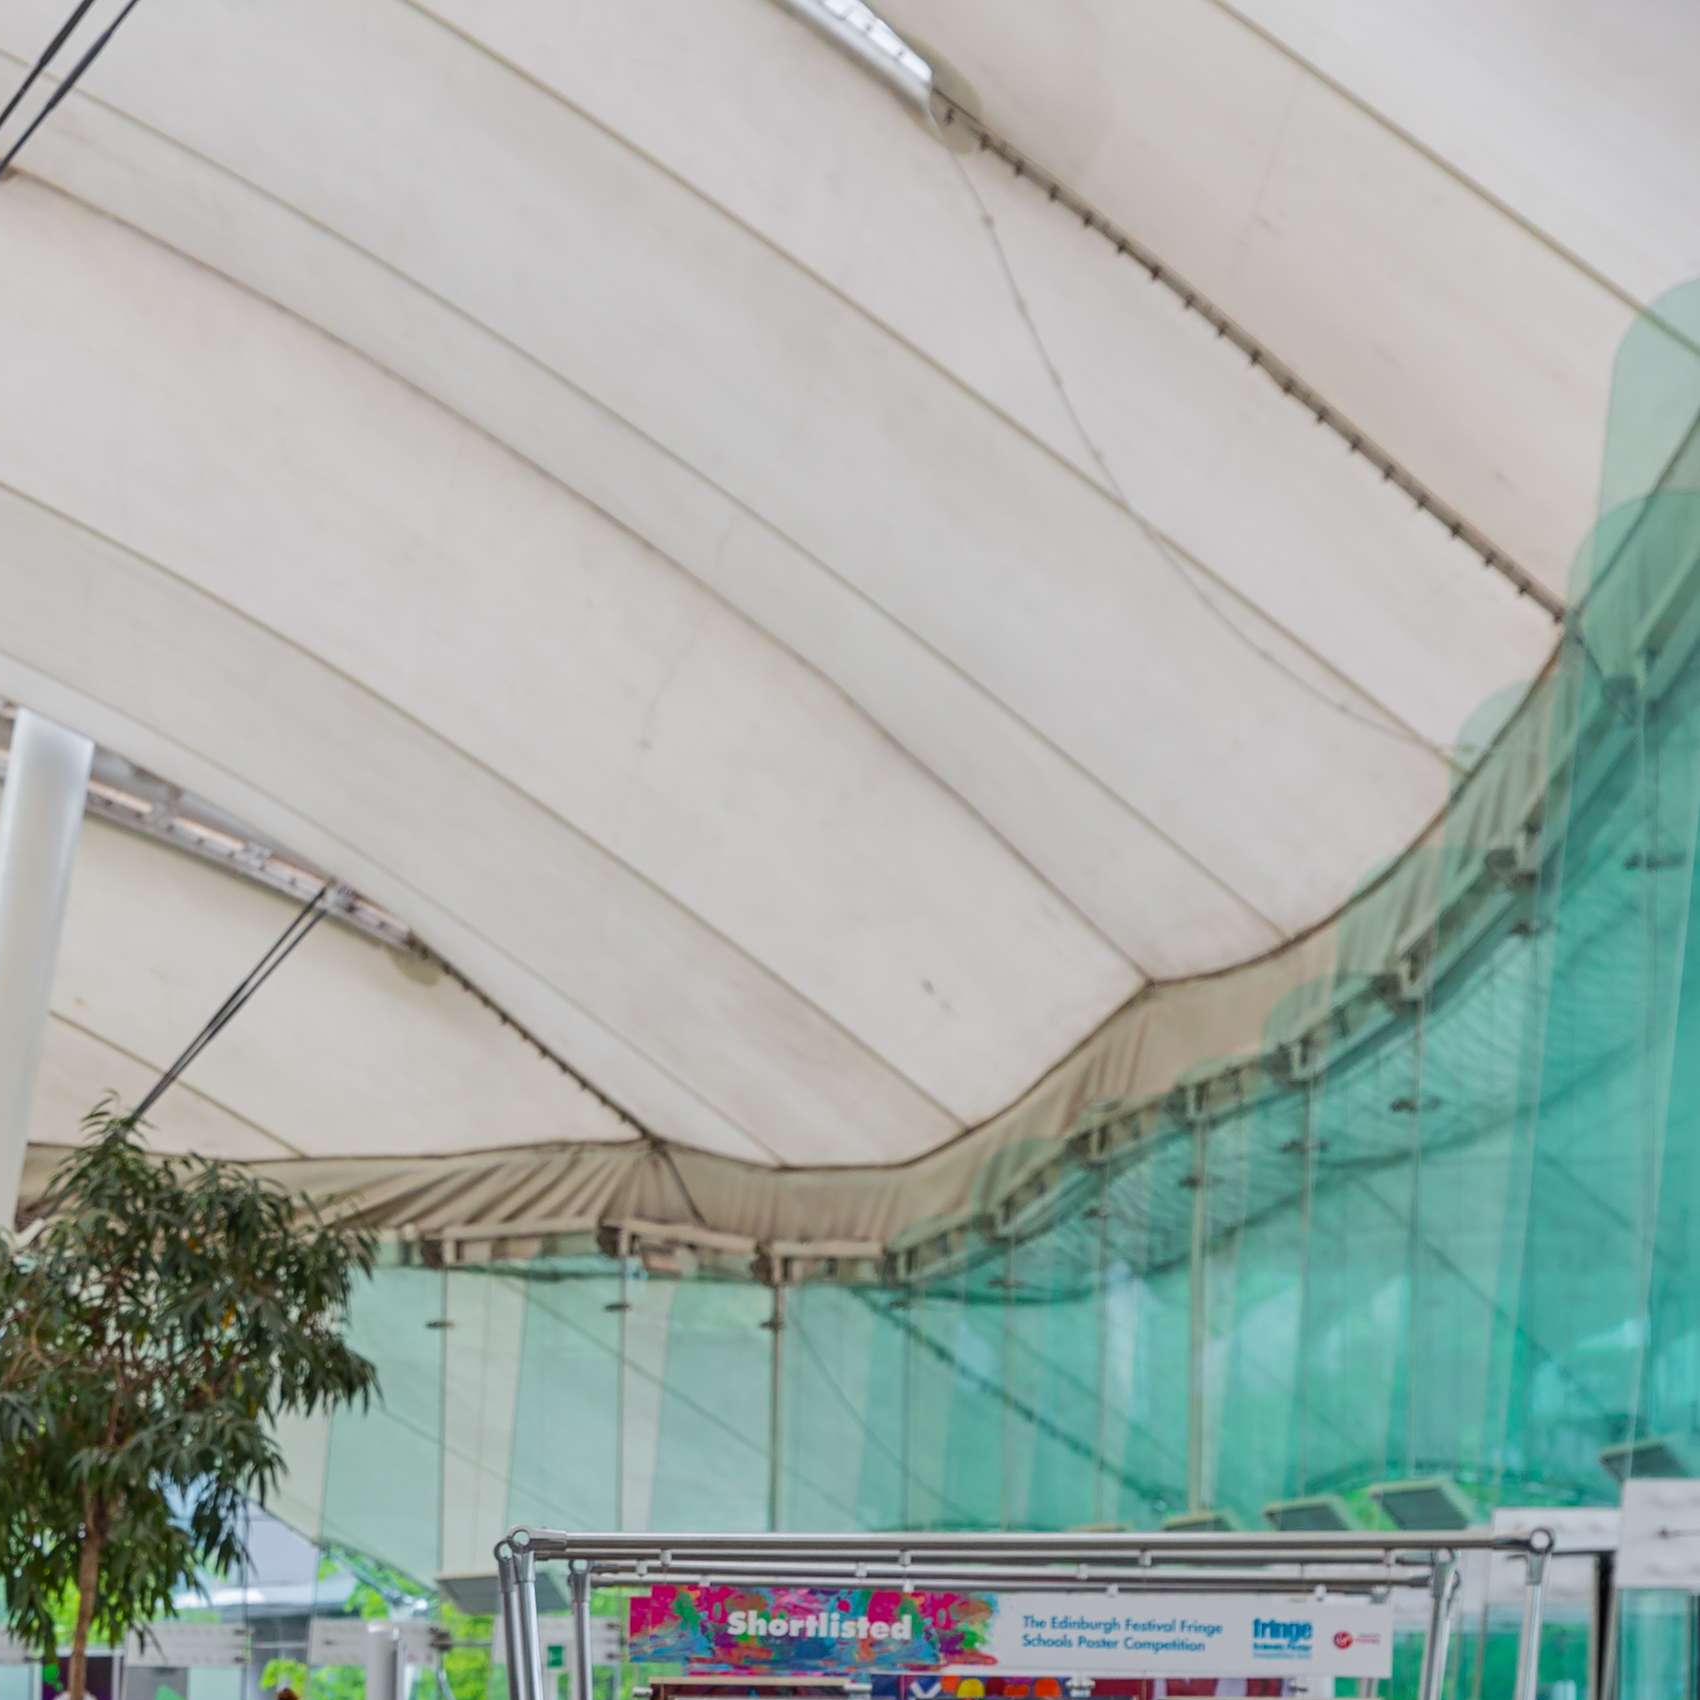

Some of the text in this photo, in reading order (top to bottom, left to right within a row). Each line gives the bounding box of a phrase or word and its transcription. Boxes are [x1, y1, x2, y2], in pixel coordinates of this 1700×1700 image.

[727, 1610, 912, 1640] Shortlisted
[1022, 1615, 1224, 1638] The Edinburgh Festival Fringe
[1252, 1617, 1313, 1643] fringe
[1022, 1633, 1206, 1654] Schools Poster Competition
